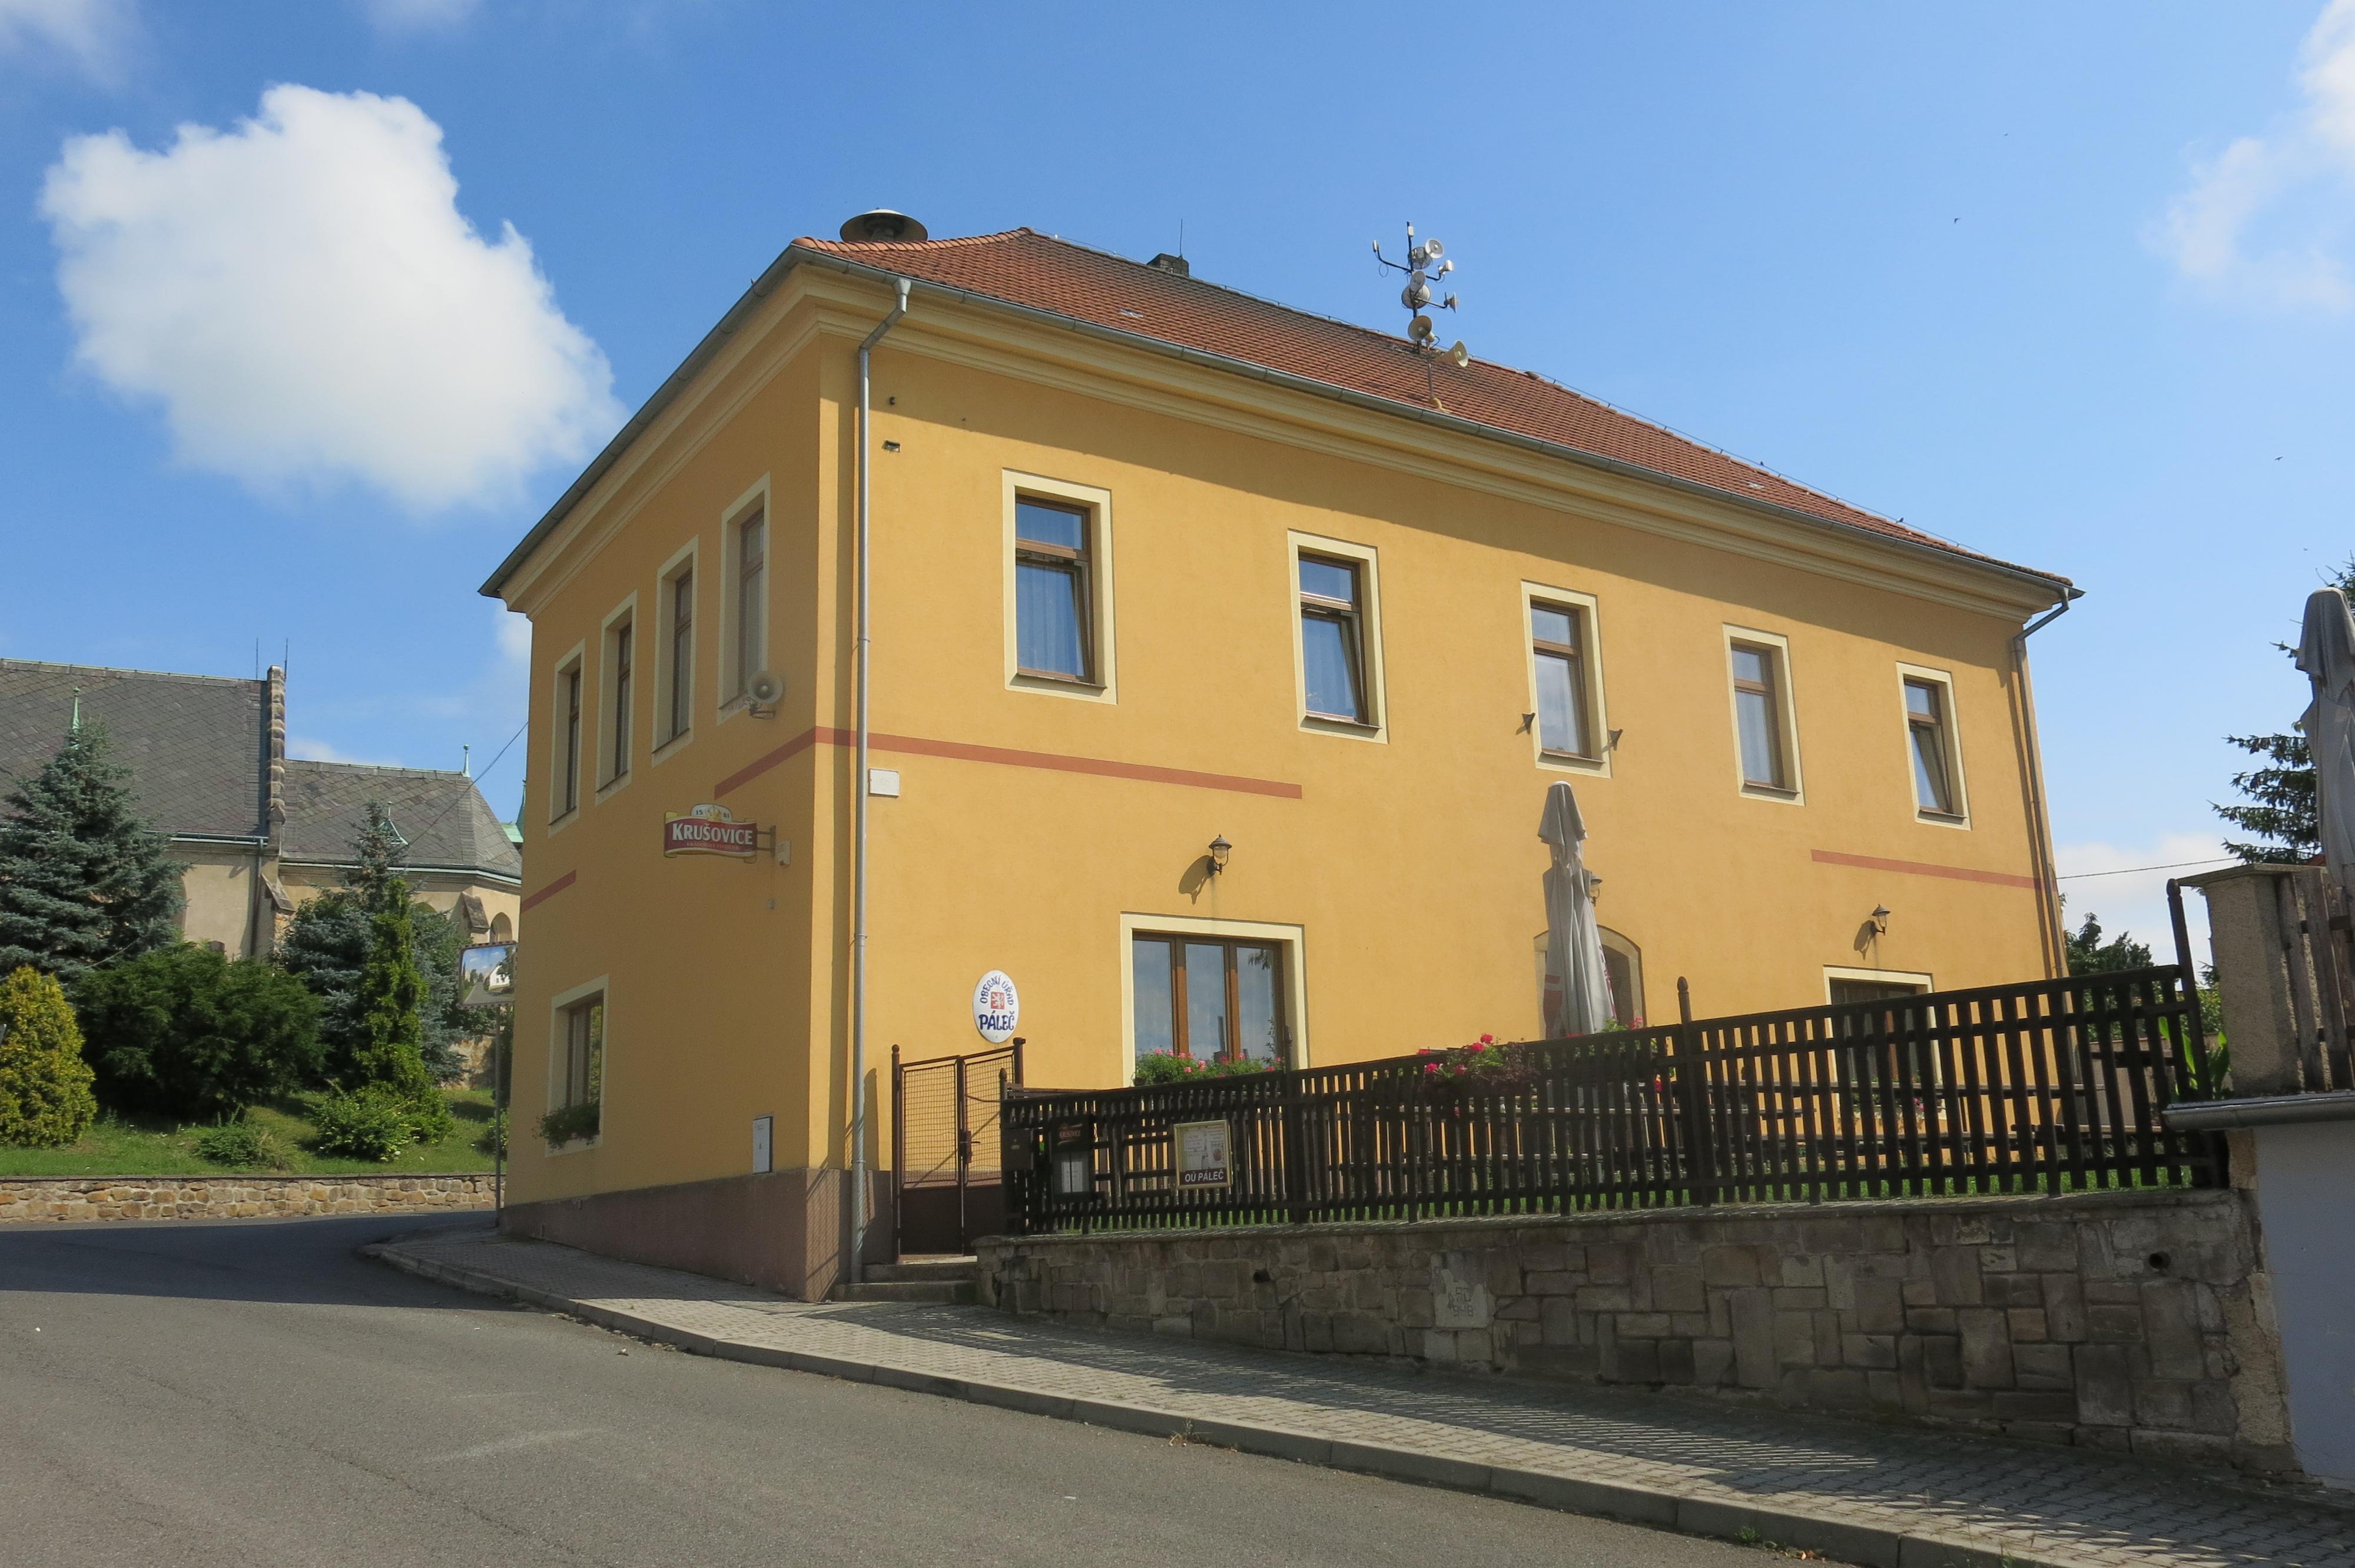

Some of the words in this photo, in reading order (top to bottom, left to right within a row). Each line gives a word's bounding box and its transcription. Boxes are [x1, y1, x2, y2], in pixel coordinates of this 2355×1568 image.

[672, 822, 753, 845] KRUŠOVICE
[980, 975, 1001, 1004] OBECNÍ
[979, 1010, 1015, 1031] PÁLEČ
[1185, 1171, 1196, 1182] OÚ
[1198, 1169, 1224, 1181] PÁLEČ
